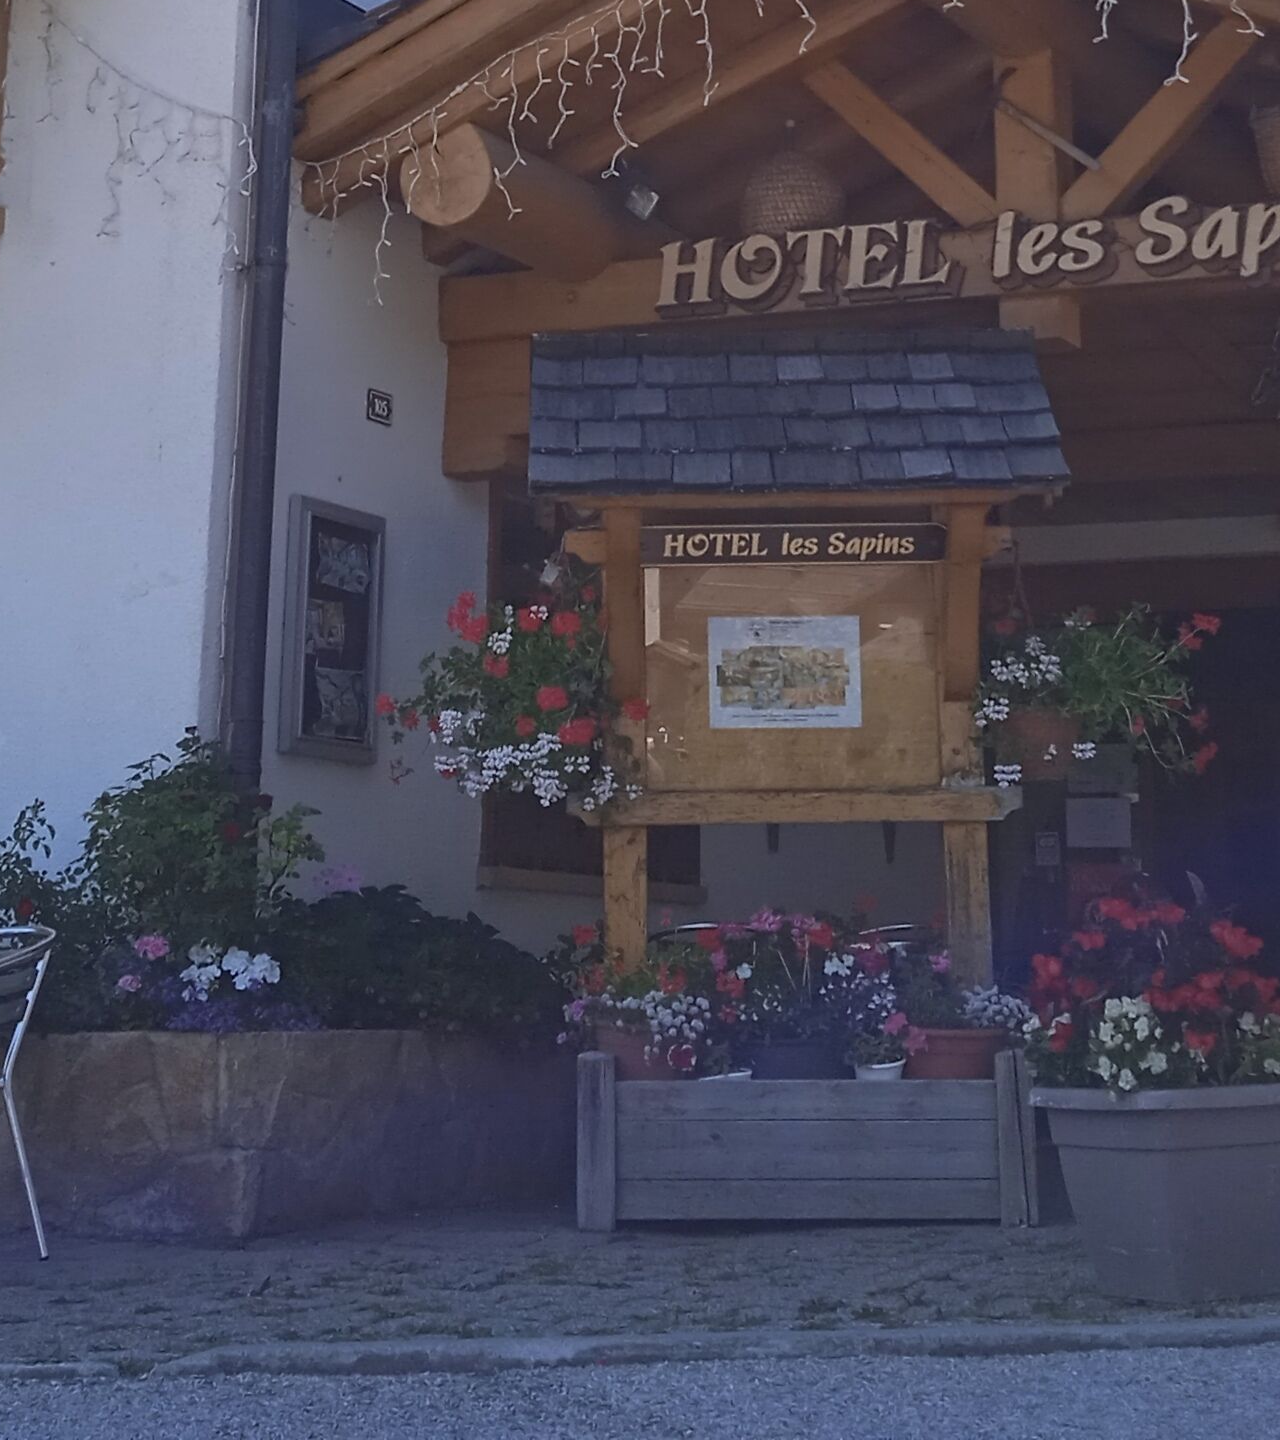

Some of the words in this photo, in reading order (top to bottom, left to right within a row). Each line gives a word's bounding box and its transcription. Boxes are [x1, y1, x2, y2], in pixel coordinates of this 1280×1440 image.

[655, 219, 952, 306] HOTEL
[992, 209, 1105, 280] les
[663, 532, 769, 558] HOTEL
[781, 532, 819, 556] les
[827, 531, 916, 561] Sapins
